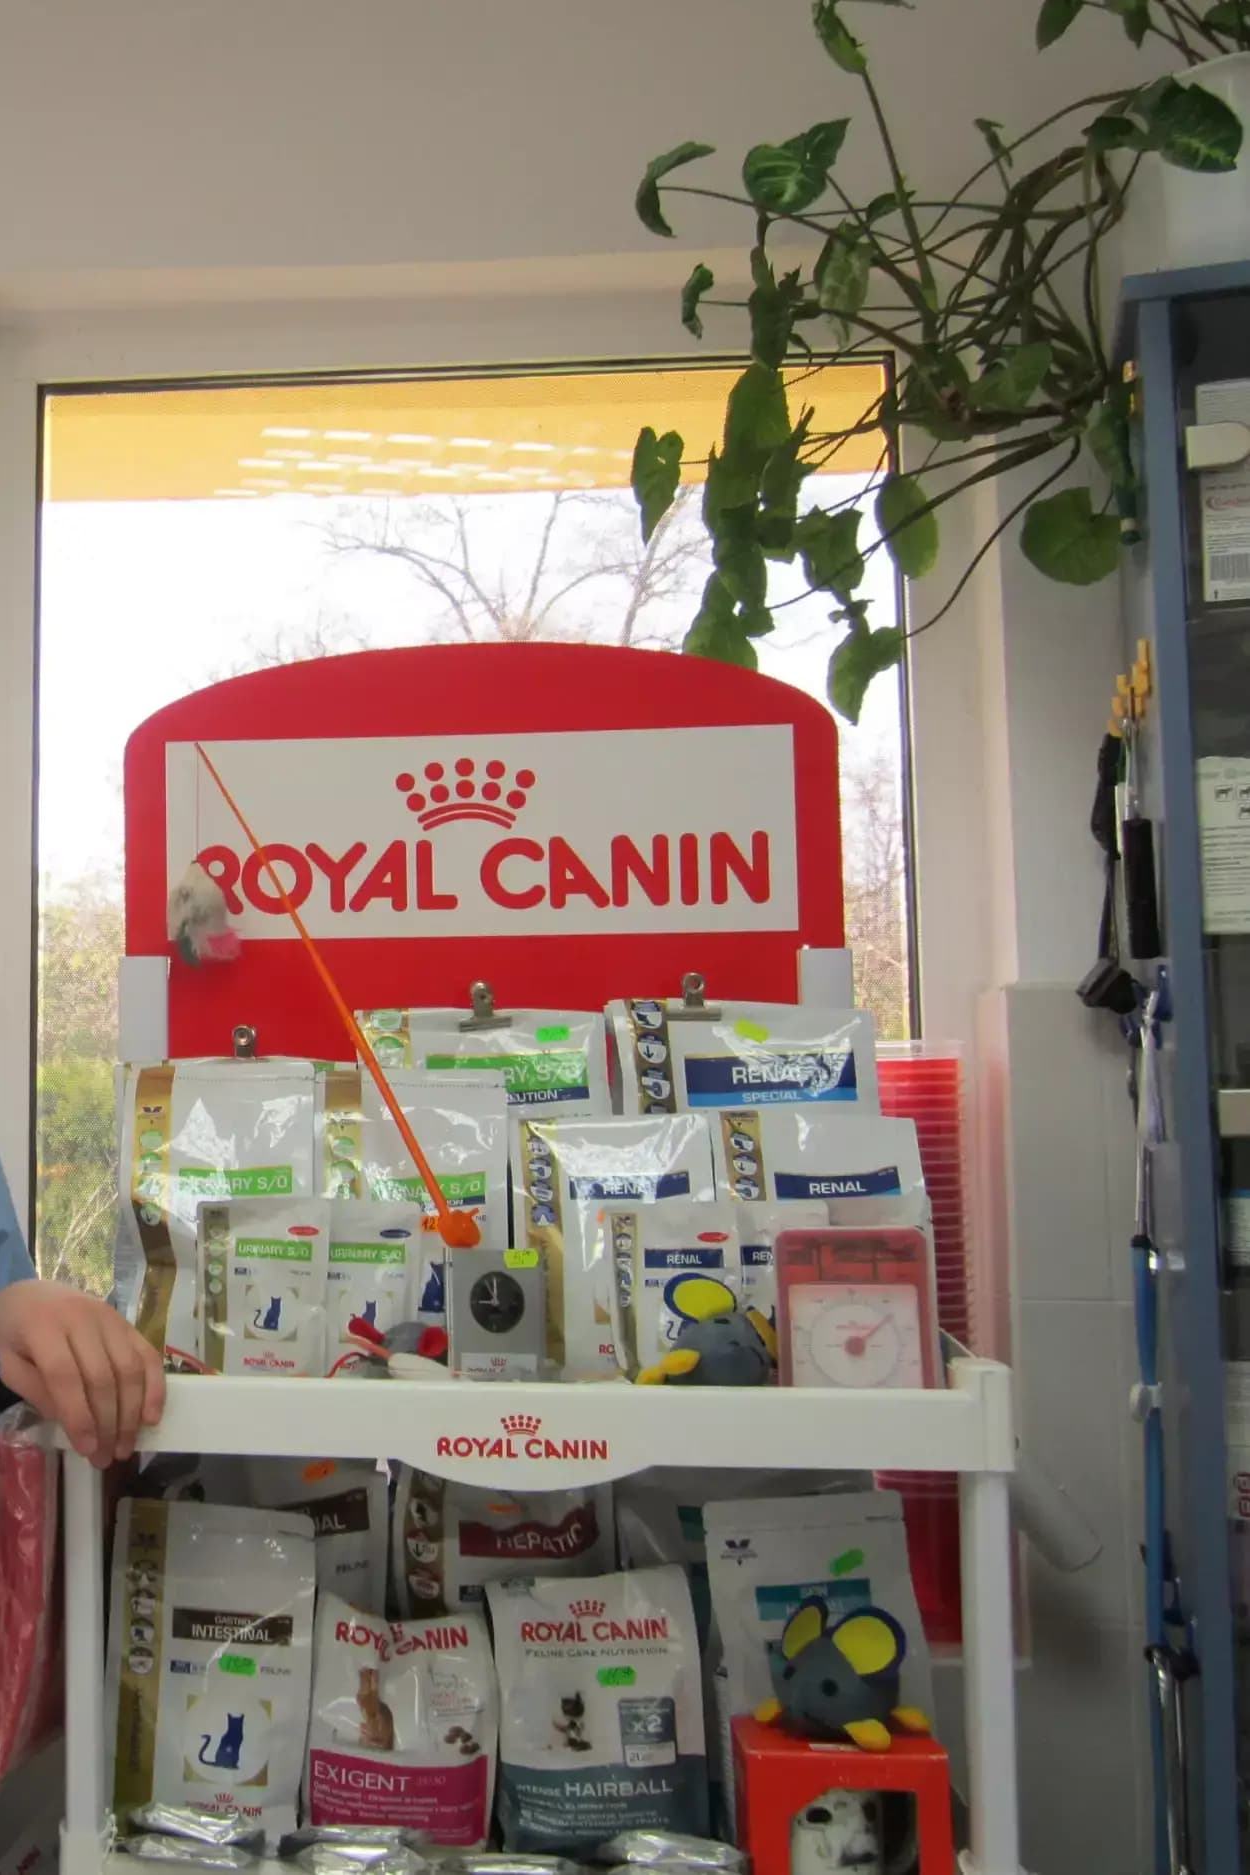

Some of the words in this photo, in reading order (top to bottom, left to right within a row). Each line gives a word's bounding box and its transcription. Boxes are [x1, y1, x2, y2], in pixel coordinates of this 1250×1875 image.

[195, 839, 459, 915] ROYAL
[479, 830, 771, 910] CANIN
[742, 1089, 802, 1103] SPECIAL
[257, 1175, 288, 1192] S/O
[451, 1180, 480, 1198] S/O
[808, 1181, 868, 1195] RENAL
[238, 1243, 284, 1256] URINARY
[330, 1247, 377, 1259] URINARY
[752, 1250, 773, 1262] REN
[666, 1253, 703, 1265] RENAL
[436, 1436, 518, 1458] ROYAL
[524, 1438, 608, 1460] CANIN
[496, 1523, 583, 1555] HEPATIC
[191, 1623, 269, 1641] INTESTINAL
[521, 1621, 587, 1643] ROYAL
[592, 1616, 669, 1642] CANIN
[601, 1647, 668, 1657] NUTRITION
[314, 1759, 412, 1793] EXIGENT
[565, 1778, 675, 1798] HAIRBALL
